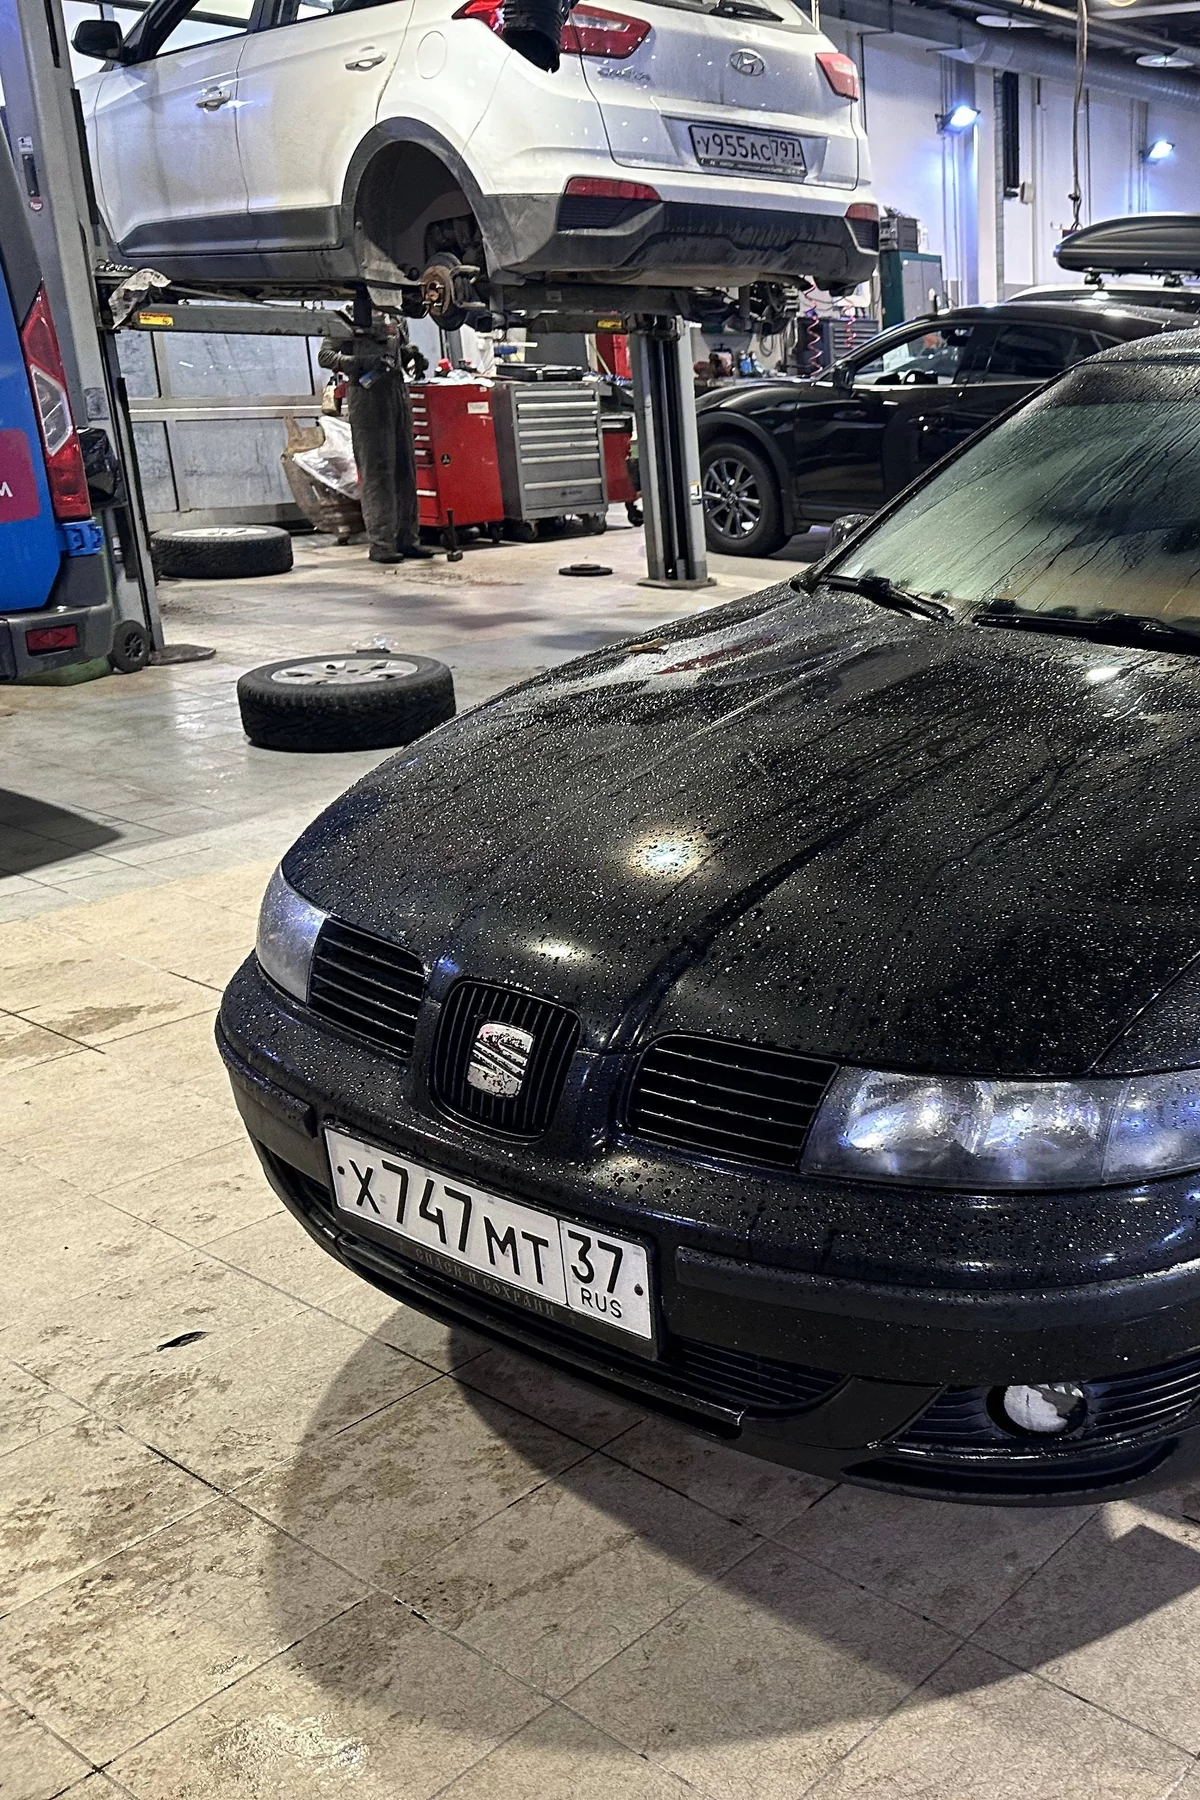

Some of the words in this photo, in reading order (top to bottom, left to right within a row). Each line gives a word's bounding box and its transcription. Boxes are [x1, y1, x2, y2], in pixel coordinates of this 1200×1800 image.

[700, 133, 771, 161] У955АС
[771, 140, 796, 159] 797
[349, 1159, 549, 1285] Х747МТ
[567, 1229, 623, 1294] 37
[581, 1287, 622, 1319] RUS
